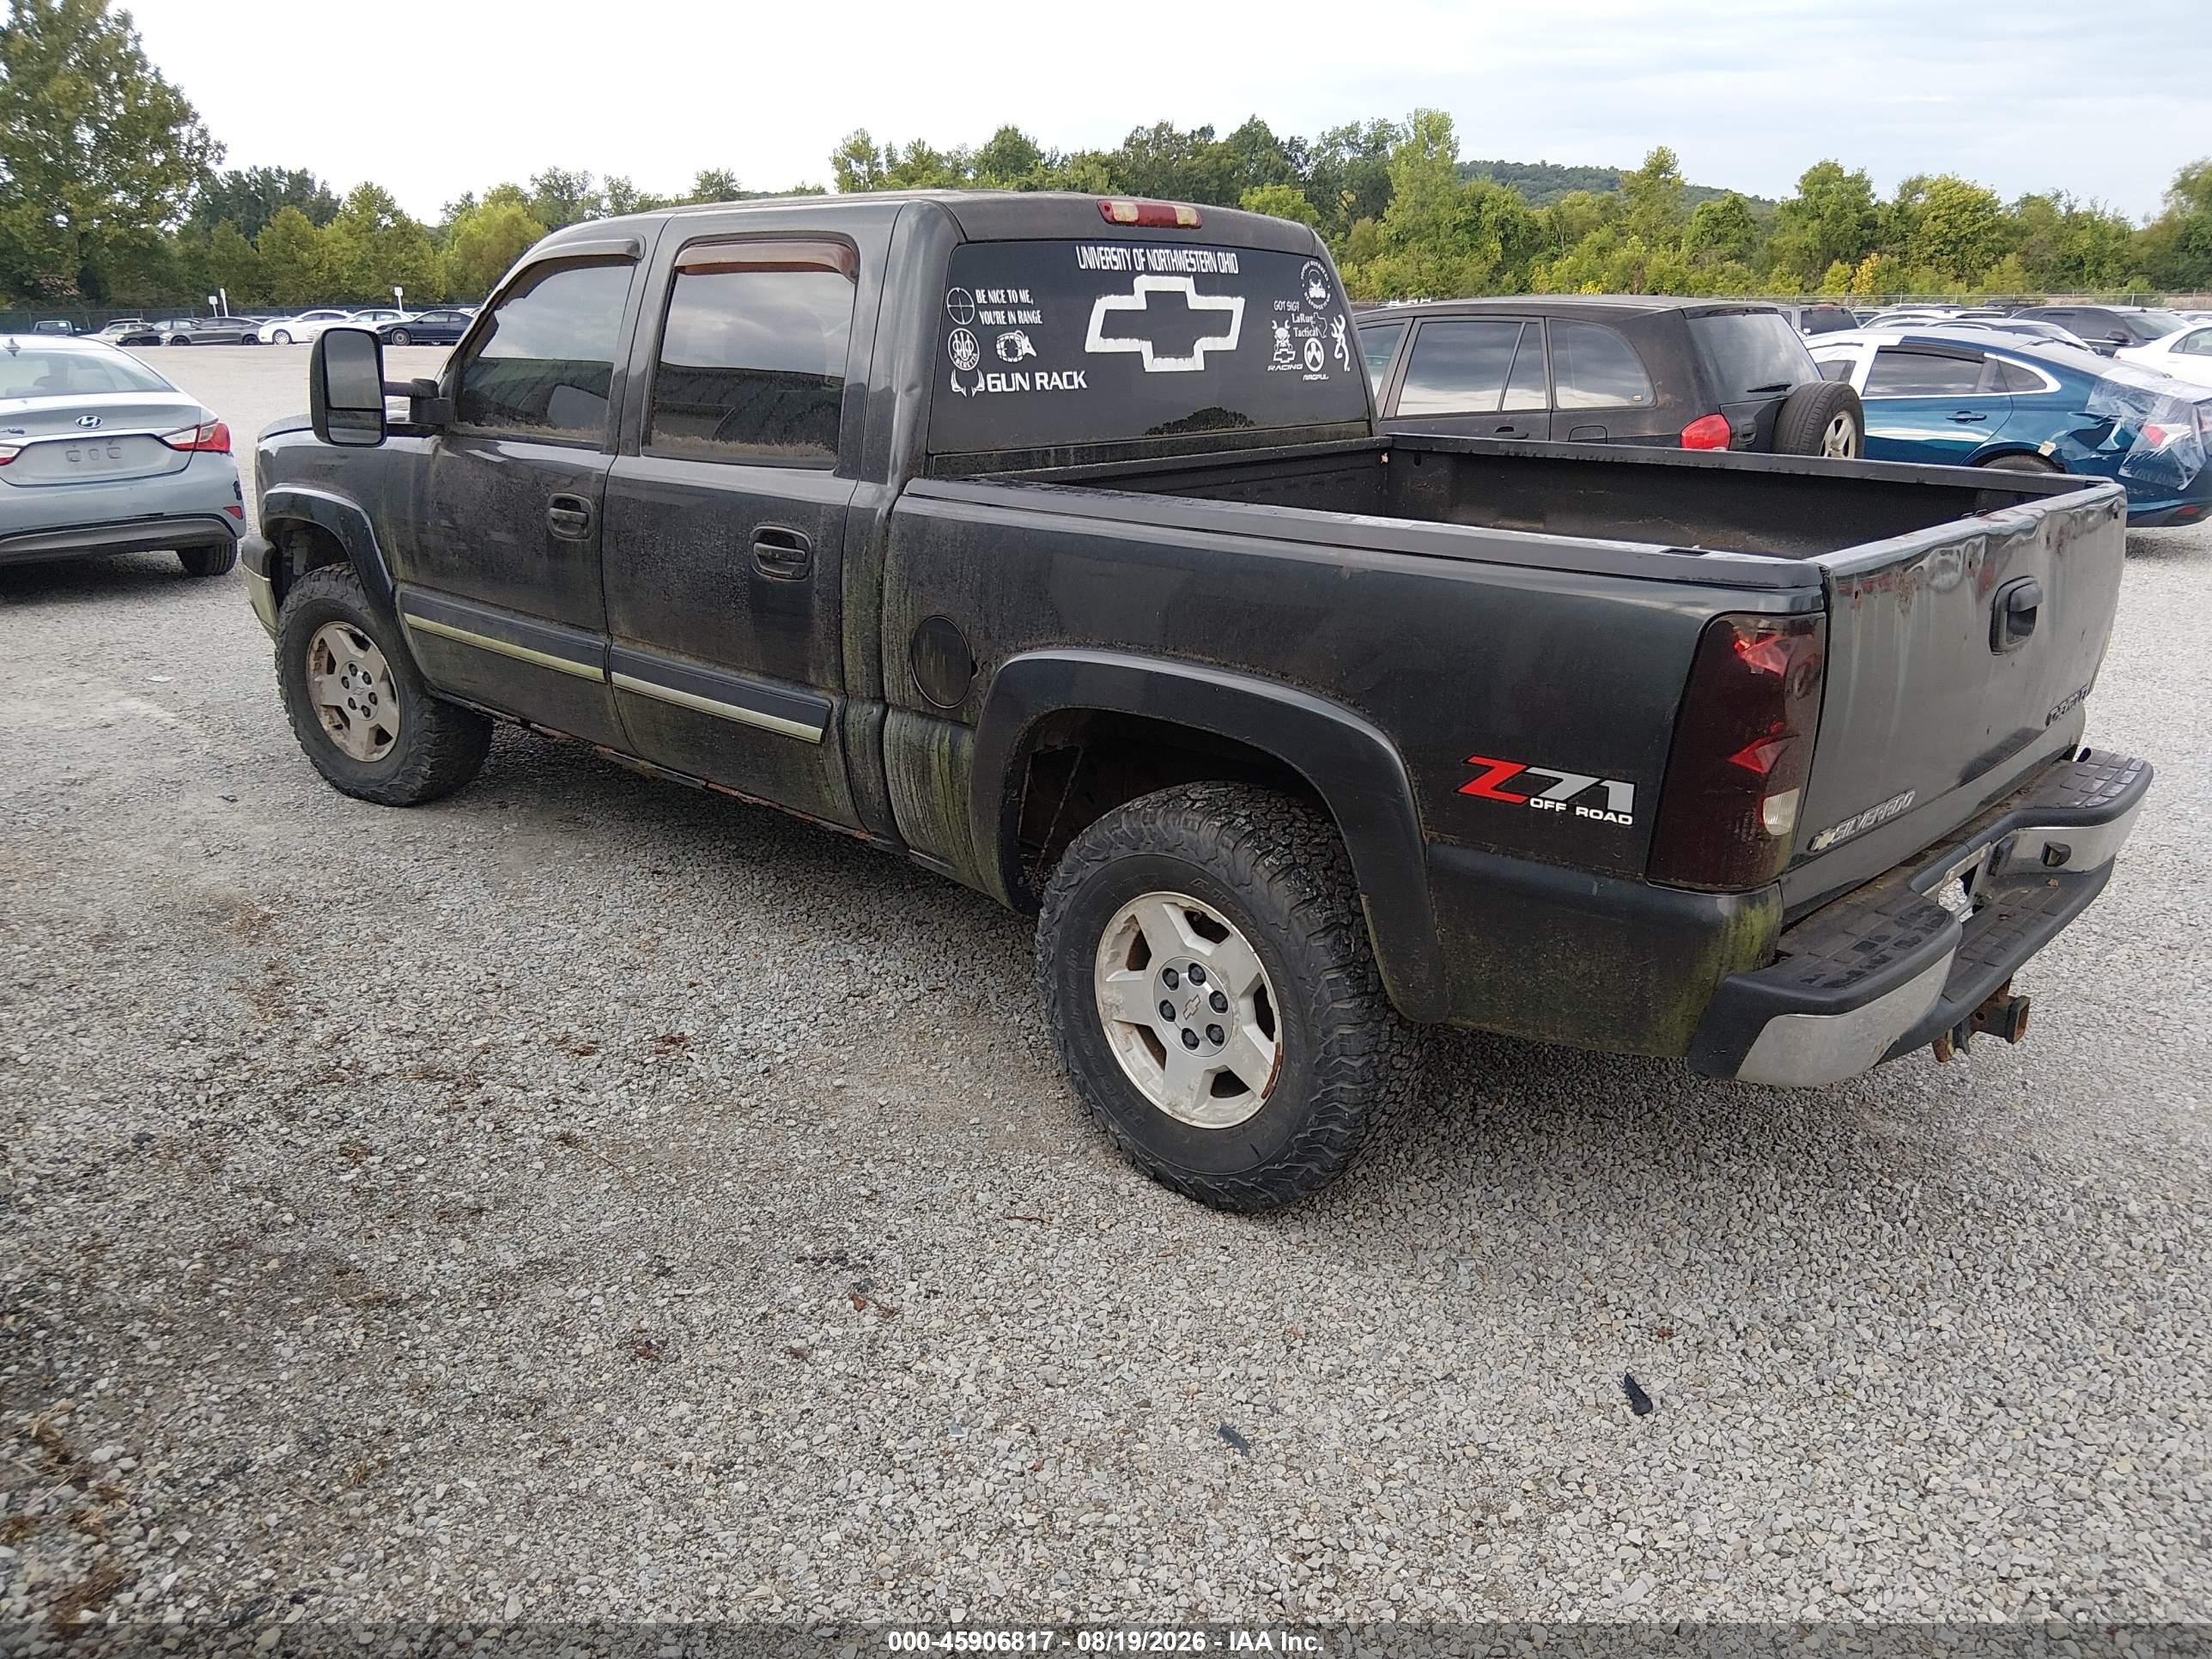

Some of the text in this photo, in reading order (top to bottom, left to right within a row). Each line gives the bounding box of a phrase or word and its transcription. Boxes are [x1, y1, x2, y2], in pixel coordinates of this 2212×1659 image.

[1075, 246, 1239, 274] UNIVERSITY OF NORTHWESTERN OHIO
[975, 289, 1034, 305] BE NICE TO ME,
[1273, 300, 1285, 311] GOT
[979, 310, 1043, 325] YOU'RE IN RANGE
[1291, 313, 1314, 323] LaRue
[1293, 326, 1319, 337] Tactical
[1267, 363, 1304, 372] RACING
[988, 370, 1088, 392] GUN RACK
[1455, 755, 1636, 814] Z71
[1529, 797, 1633, 826] OFF ROAD
